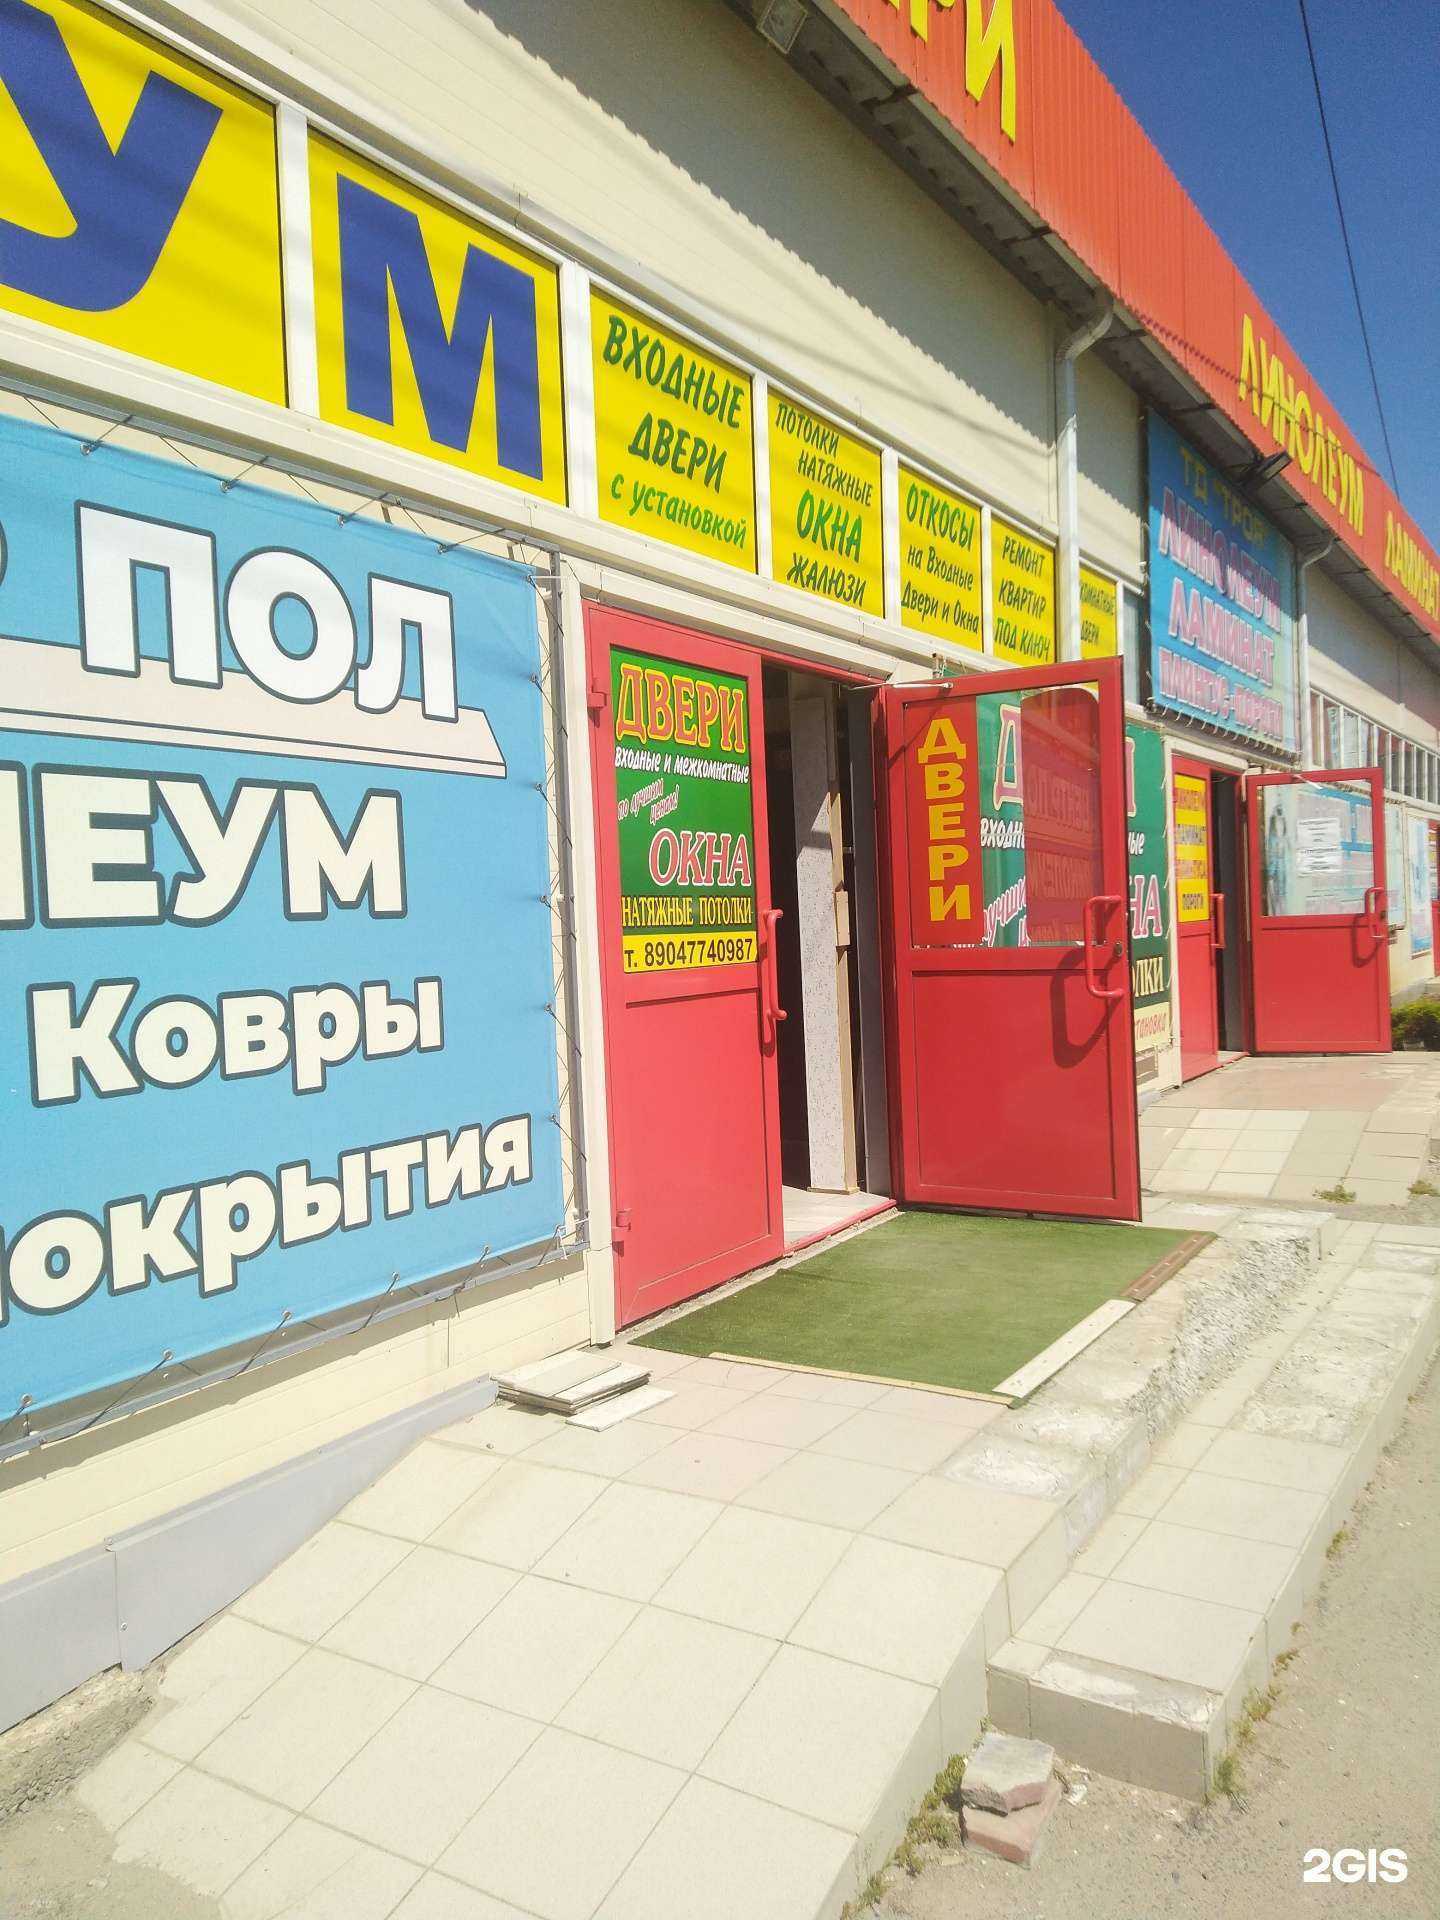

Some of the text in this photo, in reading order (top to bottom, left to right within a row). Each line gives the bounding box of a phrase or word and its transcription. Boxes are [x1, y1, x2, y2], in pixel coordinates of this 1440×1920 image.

[602, 314, 745, 429] ВХОДНЫЕ
[628, 413, 728, 494] ДВЕРИ
[775, 402, 840, 459] ПОТОЛКИ
[1239, 313, 1363, 536] ЛИНОЛЕУМ
[610, 473, 748, 549] с установкой
[797, 450, 873, 507] НАТЯЖНЫЕ
[797, 489, 863, 563] ОКНА
[906, 482, 975, 551] ОТКОСЫ
[786, 552, 867, 607] ЖАЛЮЗИ
[907, 545, 974, 592] на Входные
[1002, 535, 1046, 578] РЕМОНТ
[74, 500, 458, 722] ПОЛ
[901, 580, 980, 635] Двери и Окна
[998, 578, 1047, 619] КВАРТИР
[1168, 576, 1274, 688] ЛАМИНАТ
[995, 617, 1050, 663] ПОД КЛЮЧ
[615, 662, 746, 754] ДВЕРИ
[0, 760, 407, 930] ЕУМ
[917, 717, 972, 922] ДВЕРИ
[649, 828, 752, 887] ОКНА
[622, 896, 753, 928] НАТЯЖНЫЕ ПОТОЛКИ
[644, 938, 753, 967] 89047740987
[1132, 956, 1165, 998] ЛКИ
[28, 975, 443, 1107] Ковры
[0, 1113, 532, 1330] окрытия
